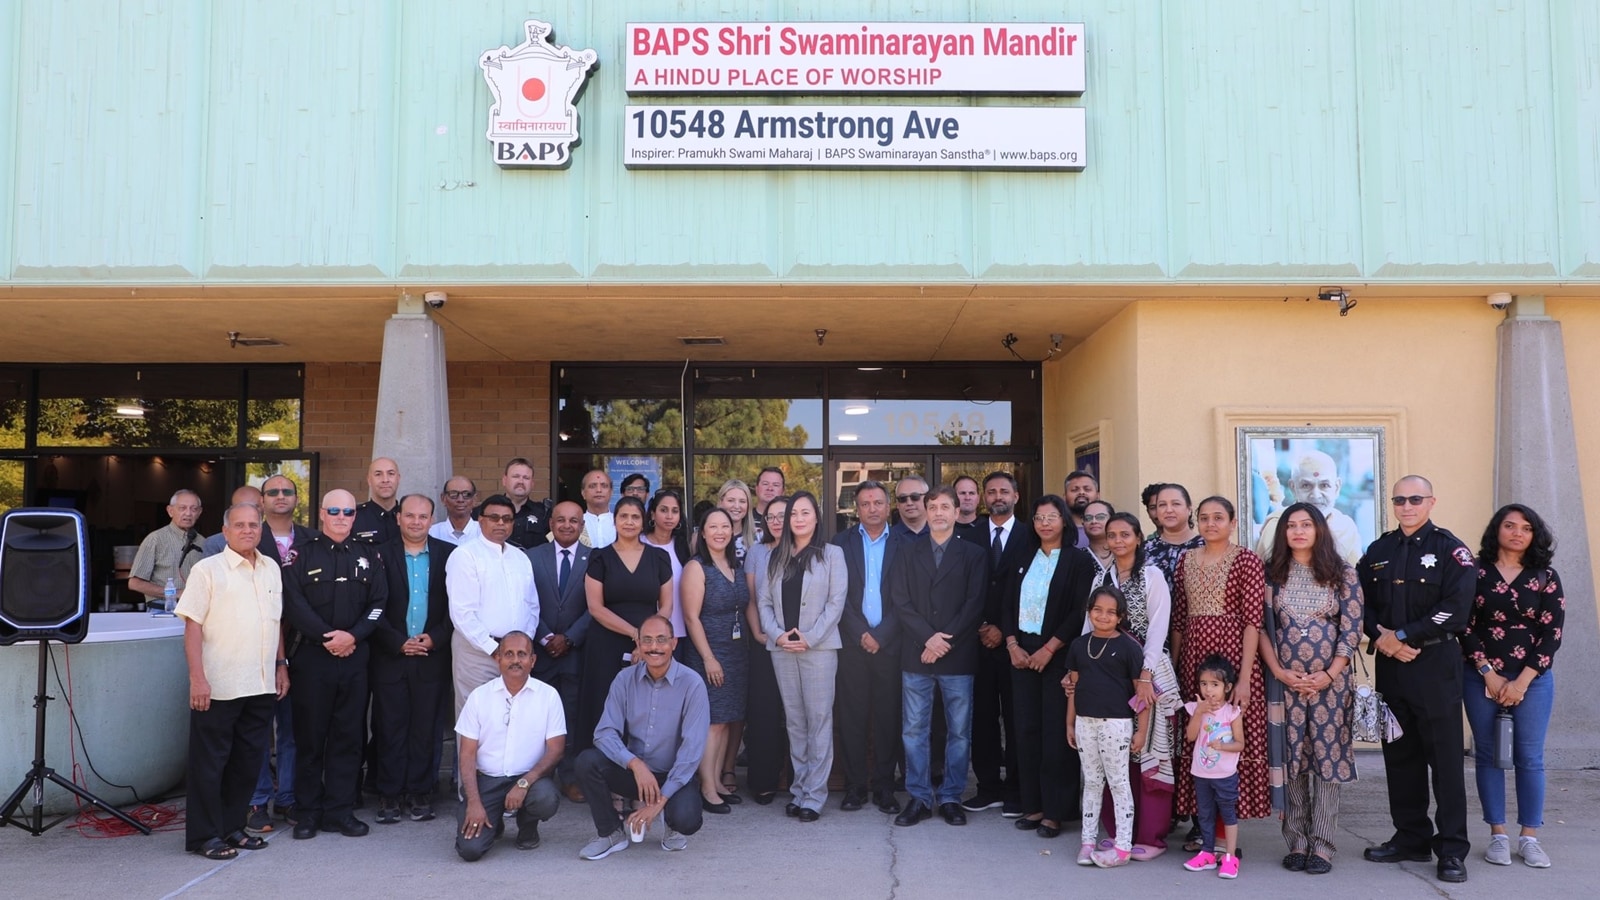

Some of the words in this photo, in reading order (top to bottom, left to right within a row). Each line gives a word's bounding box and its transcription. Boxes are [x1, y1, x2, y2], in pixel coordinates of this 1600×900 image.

[634, 27, 709, 56] BAPS
[718, 26, 771, 56] Shri
[780, 26, 975, 63] Swaminarayan
[984, 27, 1077, 56] Mandir
[634, 69, 648, 85] A
[655, 69, 720, 85] HINDU
[728, 69, 798, 85] PLACE
[806, 68, 834, 85] OF
[841, 68, 942, 85] WORSHIP
[498, 119, 567, 131] स्वामिनारायण
[632, 110, 725, 139] 10548
[734, 110, 894, 147] Armstrong
[903, 110, 960, 139] Ave
[497, 142, 565, 161] BAPS
[631, 148, 675, 160] Inspirer:
[678, 148, 726, 159] Pramukh
[729, 148, 766, 159] Swami
[769, 148, 813, 161] Maharaj
[825, 148, 855, 160] BAPS
[858, 148, 937, 162] Swaminarayan
[1000, 149, 1078, 163] www.baps.org
[884, 411, 986, 437] 10548
